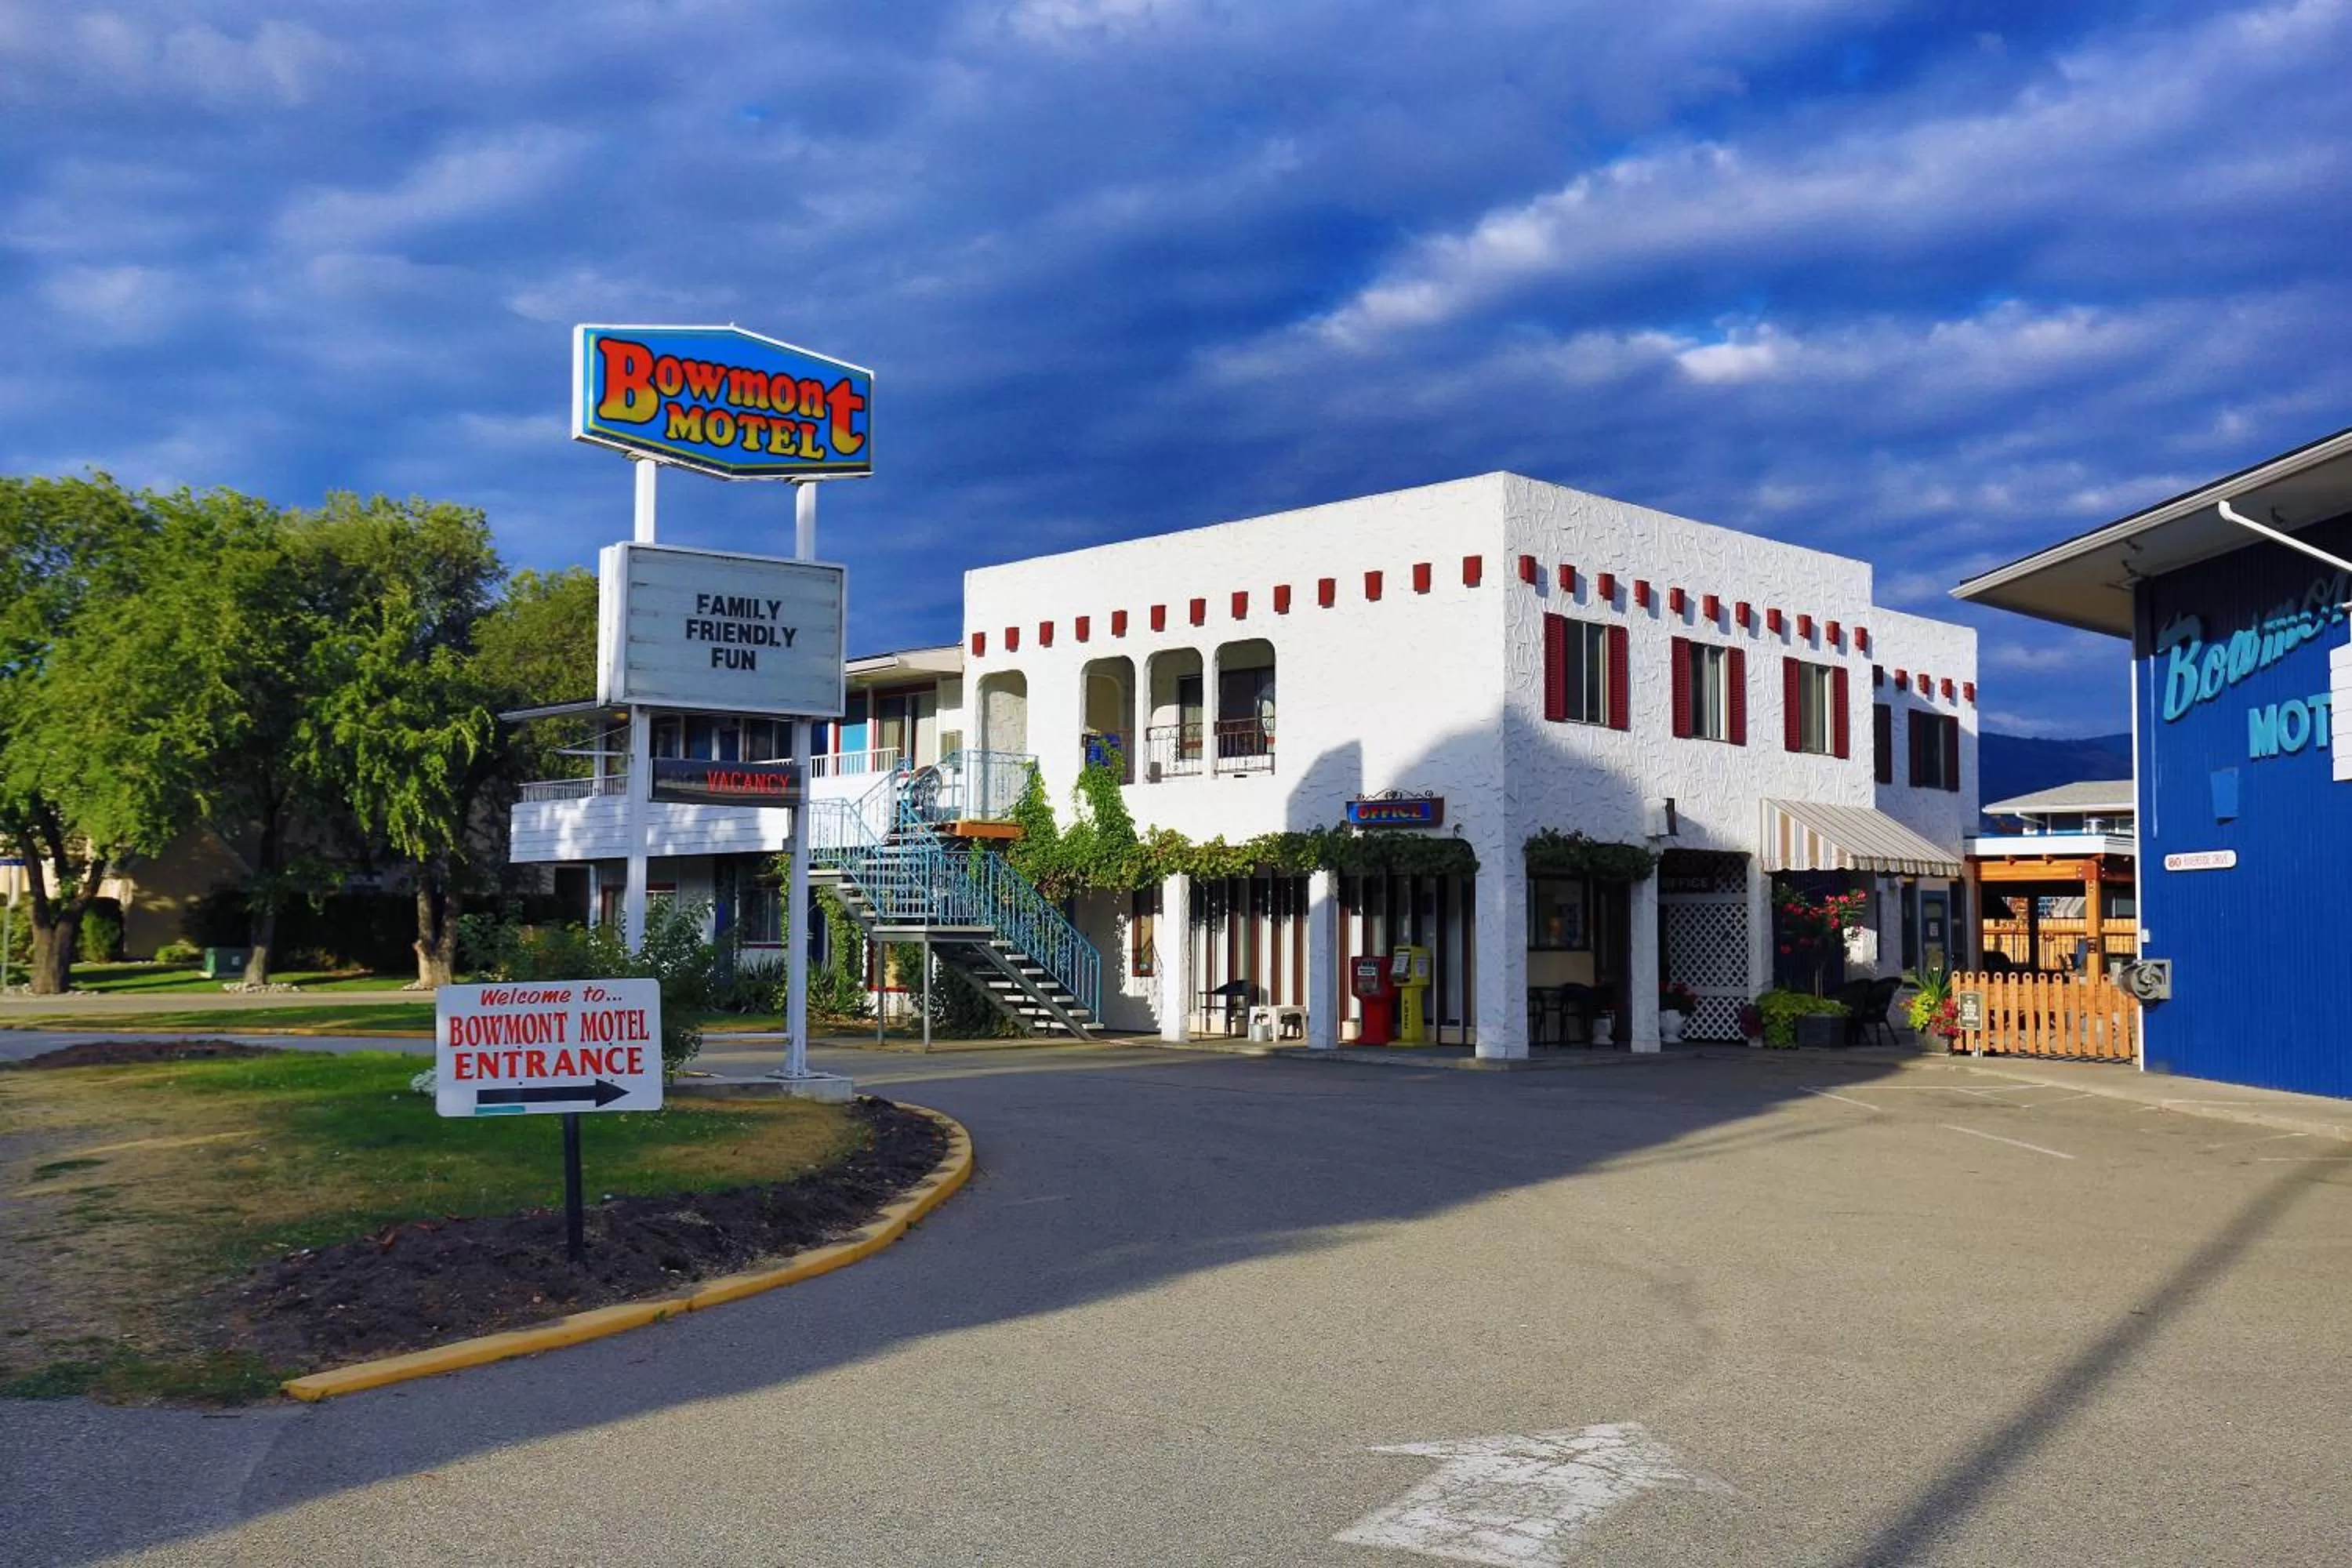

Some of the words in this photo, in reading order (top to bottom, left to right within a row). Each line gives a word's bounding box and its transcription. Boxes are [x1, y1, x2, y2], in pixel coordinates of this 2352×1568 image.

[597, 338, 865, 455] Bowmont
[665, 402, 826, 460] MOTEL
[696, 593, 782, 620] FAMILY
[685, 619, 798, 648] FRIENDLY
[710, 647, 757, 670] FUN
[706, 769, 790, 794] VACANCY
[480, 988, 572, 1006] Welcome
[449, 1011, 568, 1047] BOWMONT
[579, 1010, 650, 1042] MOTEL
[454, 1047, 644, 1080] ENTRANCE
